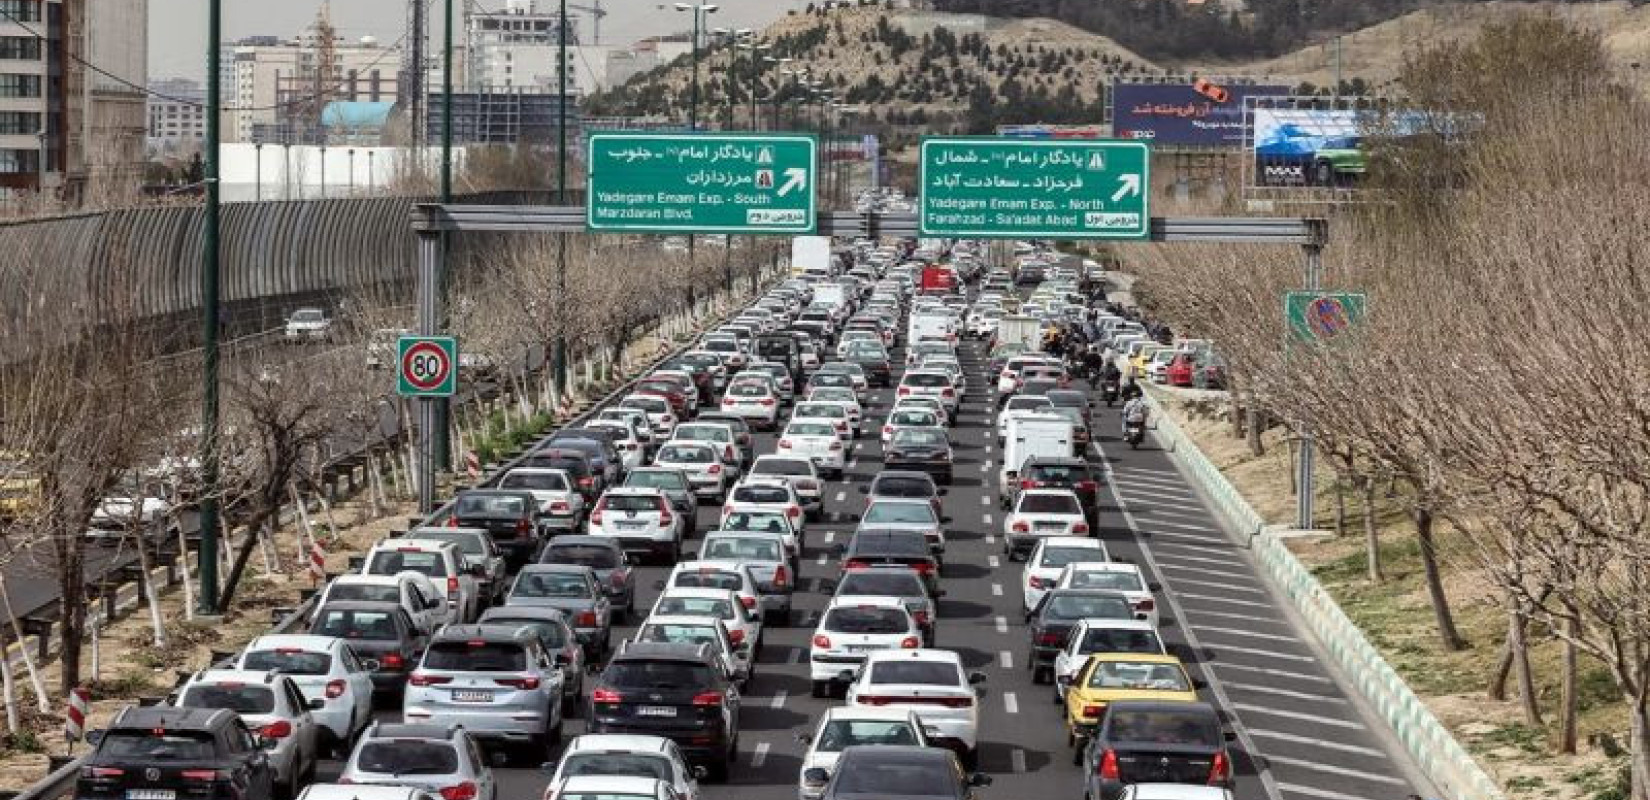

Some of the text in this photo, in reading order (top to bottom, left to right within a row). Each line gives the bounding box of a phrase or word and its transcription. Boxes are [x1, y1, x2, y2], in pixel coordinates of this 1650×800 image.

[607, 146, 653, 164] جنوب
[710, 144, 754, 163] یادگار
[935, 149, 979, 167] شمال
[1038, 149, 1084, 169] یادگار
[686, 169, 752, 188] مرزداران
[931, 171, 962, 191] آباد
[963, 174, 1020, 188] سعادت
[1032, 173, 1084, 193] فرحزاد
[597, 192, 655, 205] Yadegare
[657, 192, 696, 204] Emam
[698, 192, 725, 206] Exp.
[733, 192, 772, 204] South
[929, 198, 987, 211] Yadegare
[989, 198, 1028, 210] Emam
[1030, 198, 1057, 211] Exp.
[1069, 198, 1105, 210] North
[597, 207, 694, 219] Marzdaran Blvd.
[929, 213, 985, 225] Farahzad
[995, 213, 1043, 225] Sa'adat
[1045, 213, 1078, 225] Abad
[414, 355, 439, 377] 80
